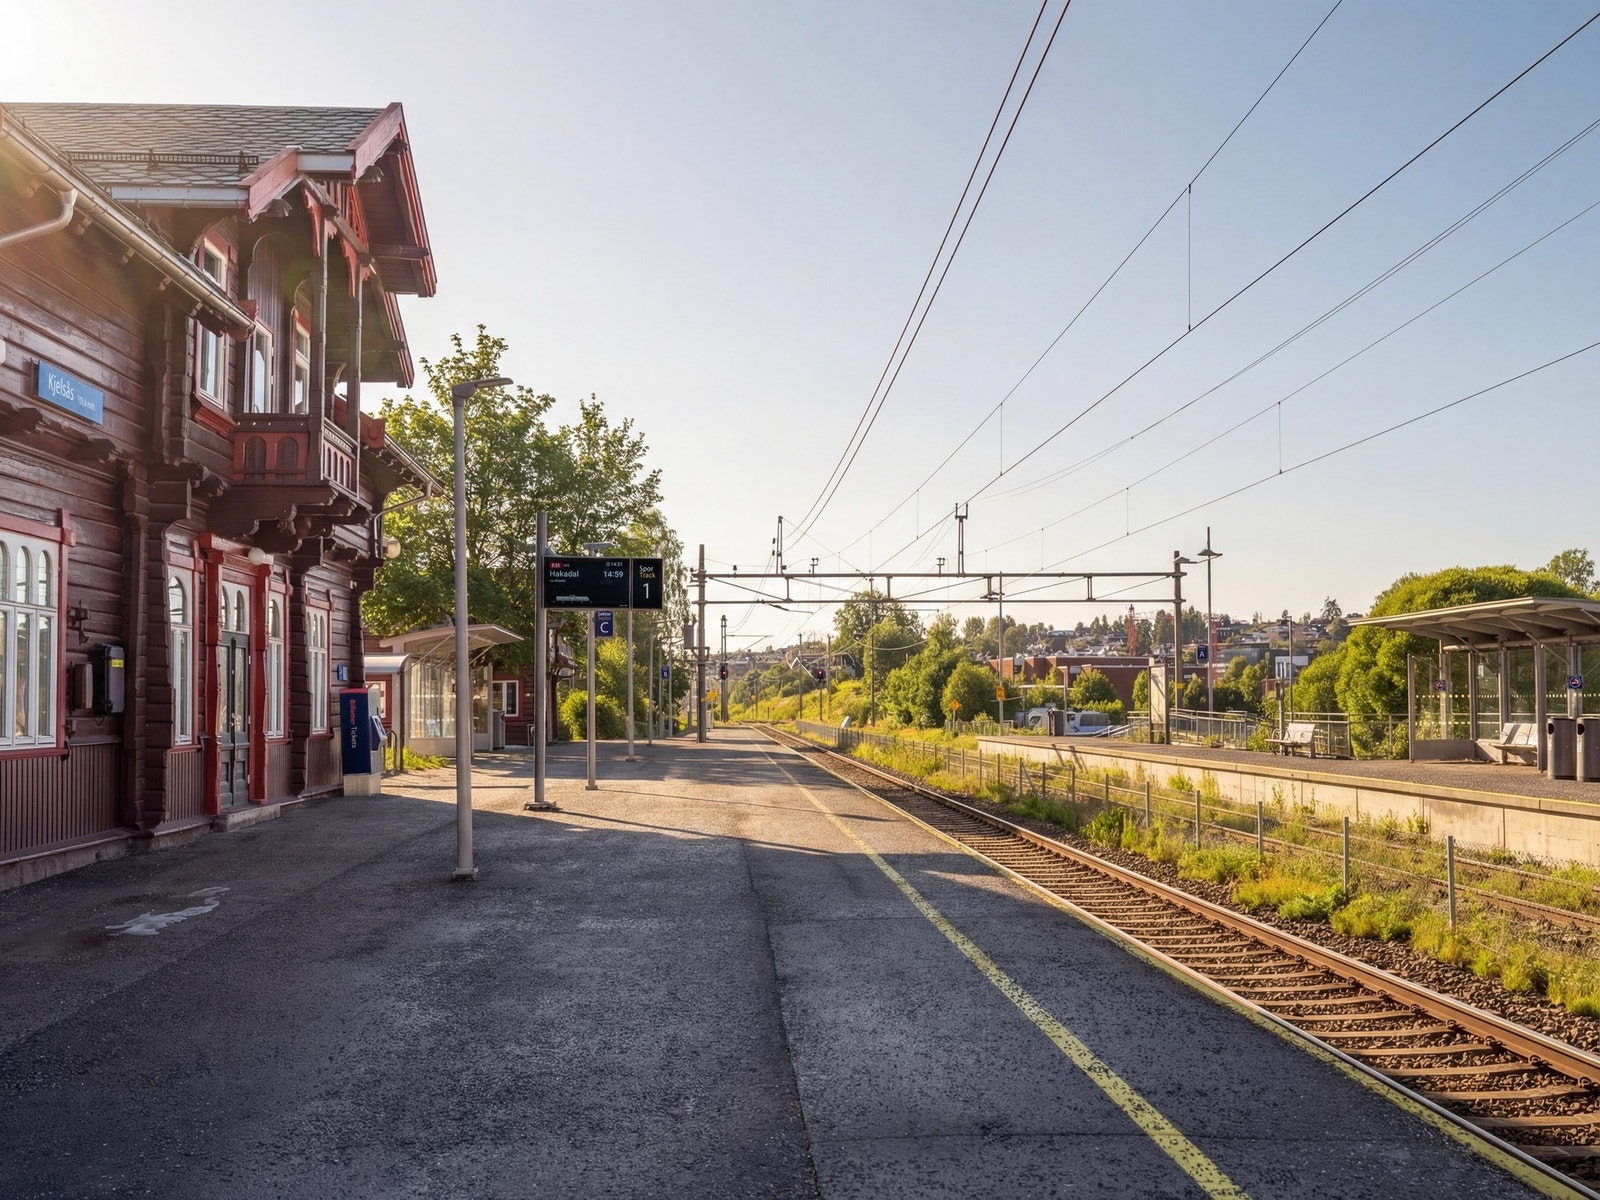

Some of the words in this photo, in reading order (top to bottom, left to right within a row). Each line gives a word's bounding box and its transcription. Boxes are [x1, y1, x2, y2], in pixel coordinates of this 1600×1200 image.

[48, 372, 74, 400] Kjelsås
[603, 570, 624, 578] 14:59
[643, 583, 649, 599] 1
[600, 621, 609, 634] C
